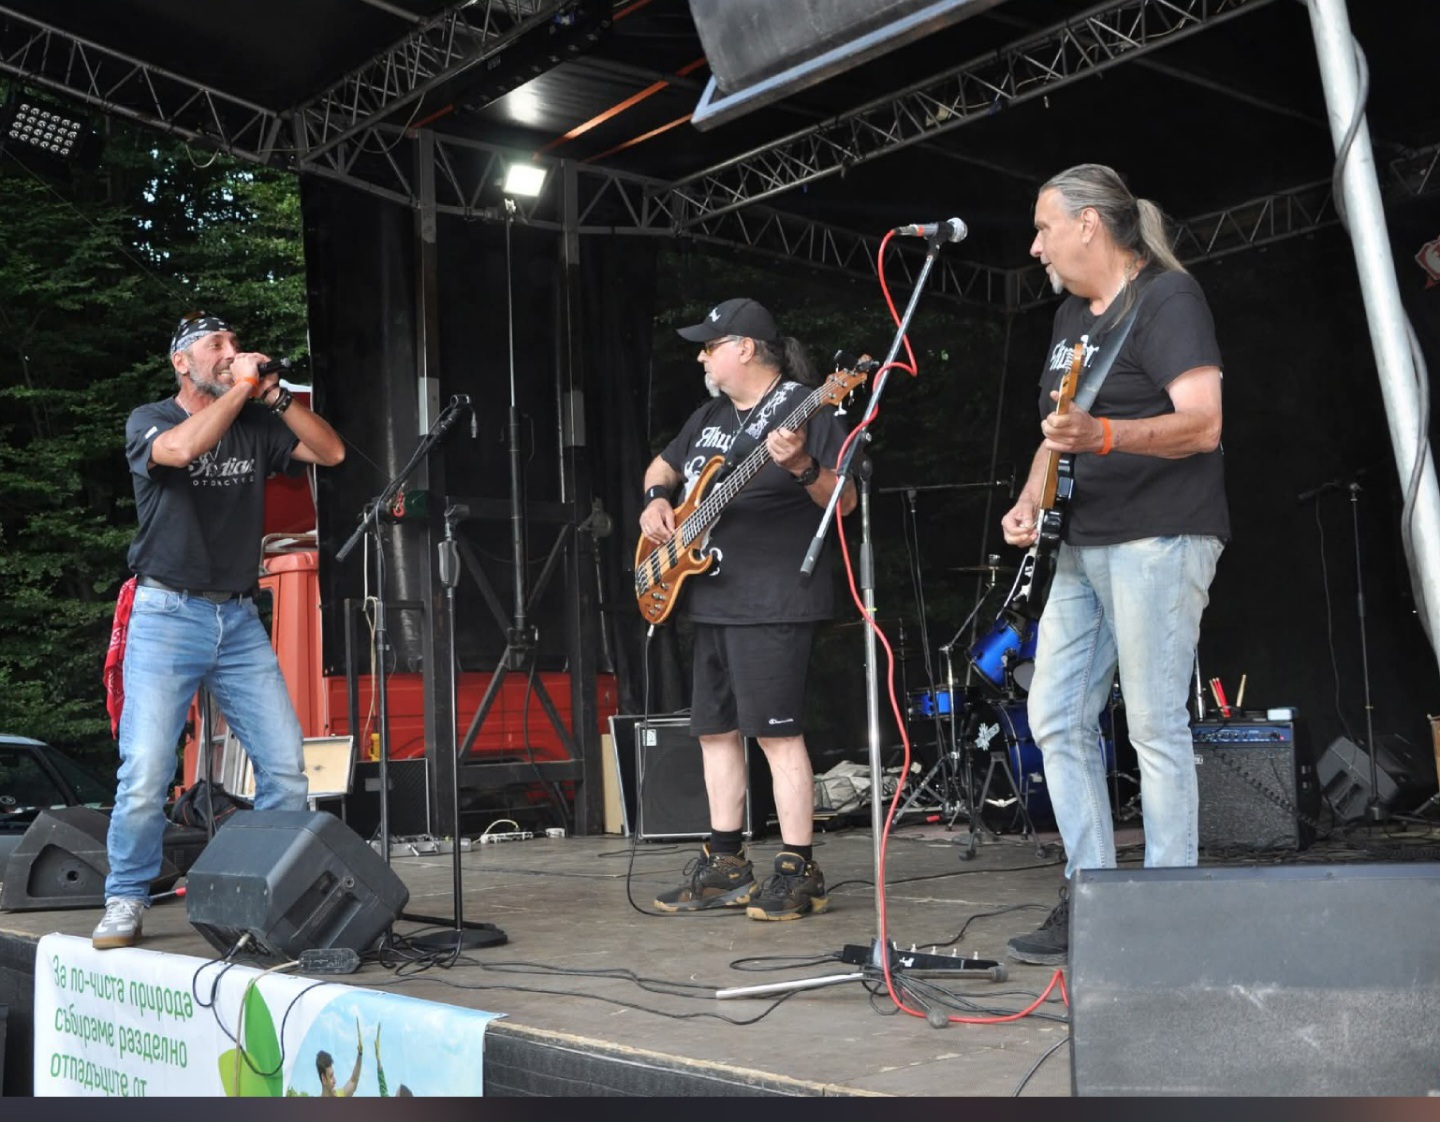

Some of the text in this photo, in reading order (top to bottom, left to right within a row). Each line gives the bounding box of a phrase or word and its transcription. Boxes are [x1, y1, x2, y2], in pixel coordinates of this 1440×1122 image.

[53, 954, 194, 1023] За по-чиста природа
[118, 1024, 188, 1069] разделно
[50, 1052, 129, 1097] отпадъците
